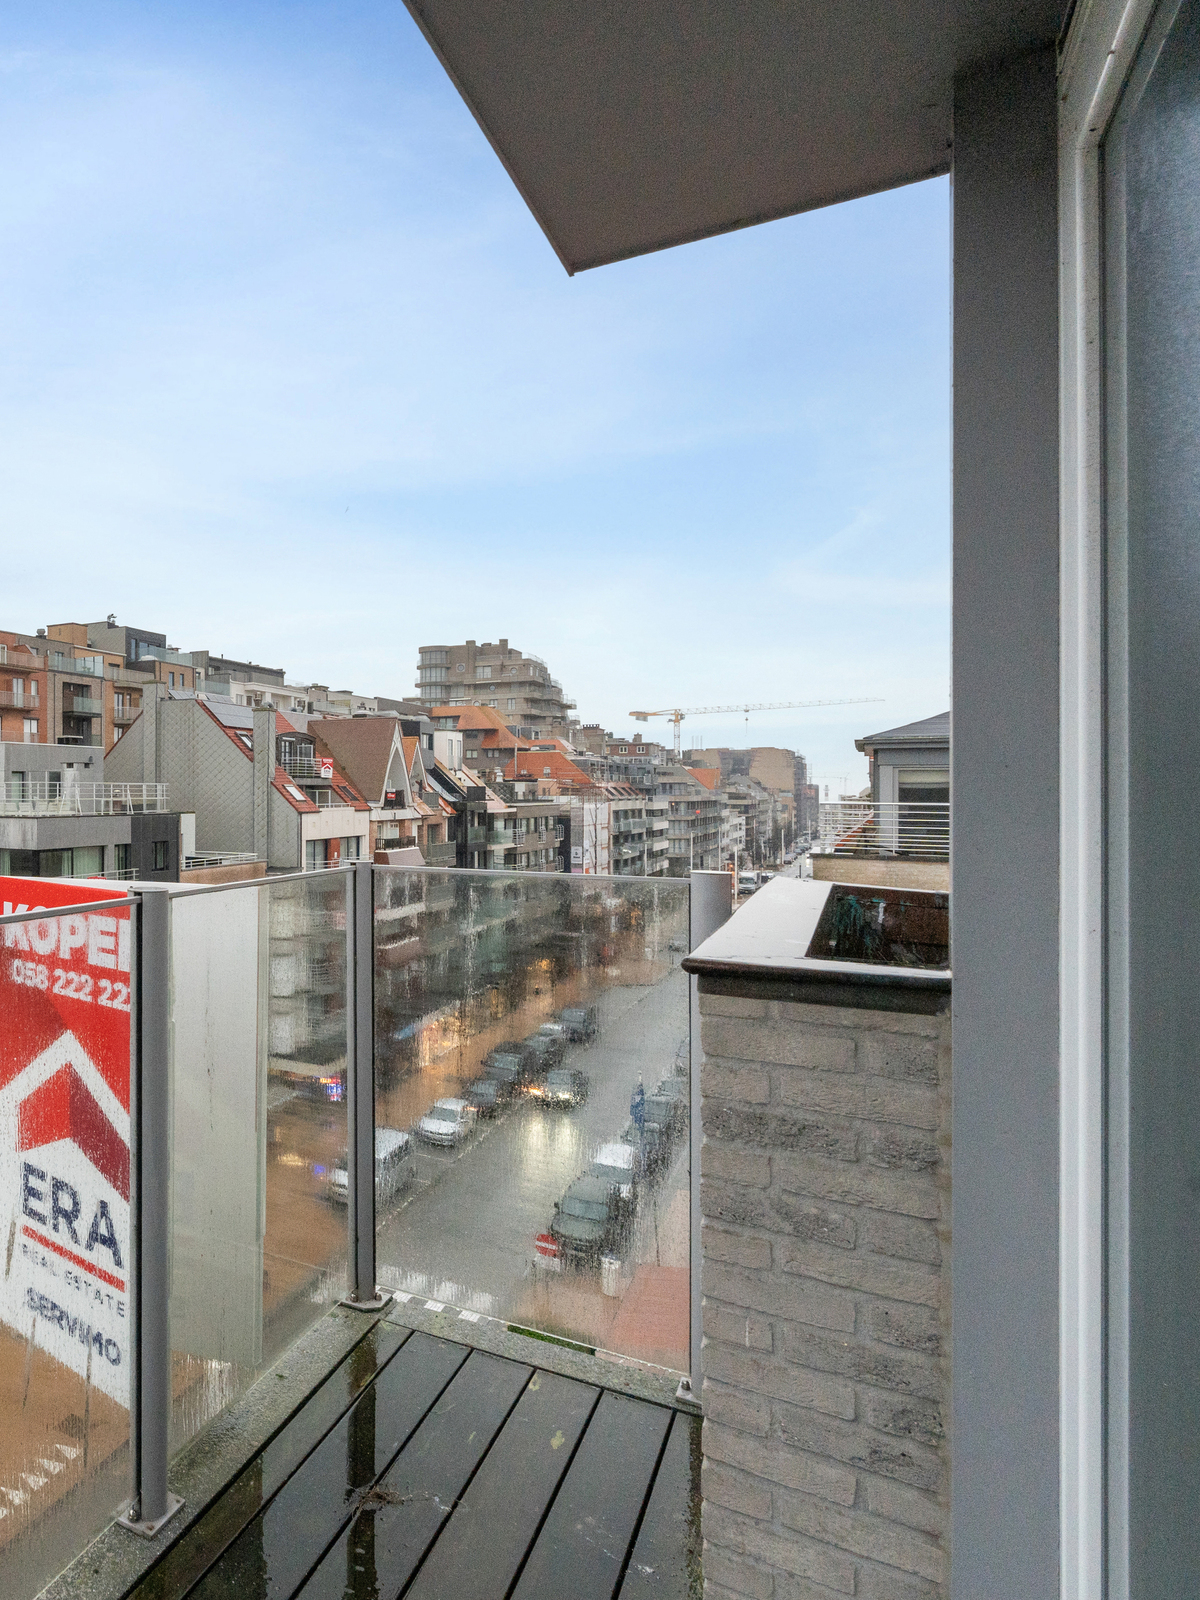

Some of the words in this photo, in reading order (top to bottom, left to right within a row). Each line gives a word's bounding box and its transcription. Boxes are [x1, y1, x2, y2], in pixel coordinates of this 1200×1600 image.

[12, 958, 49, 991] 058
[52, 968, 95, 1003] 222
[97, 978, 131, 1013] 22
[22, 1161, 124, 1270] ERA
